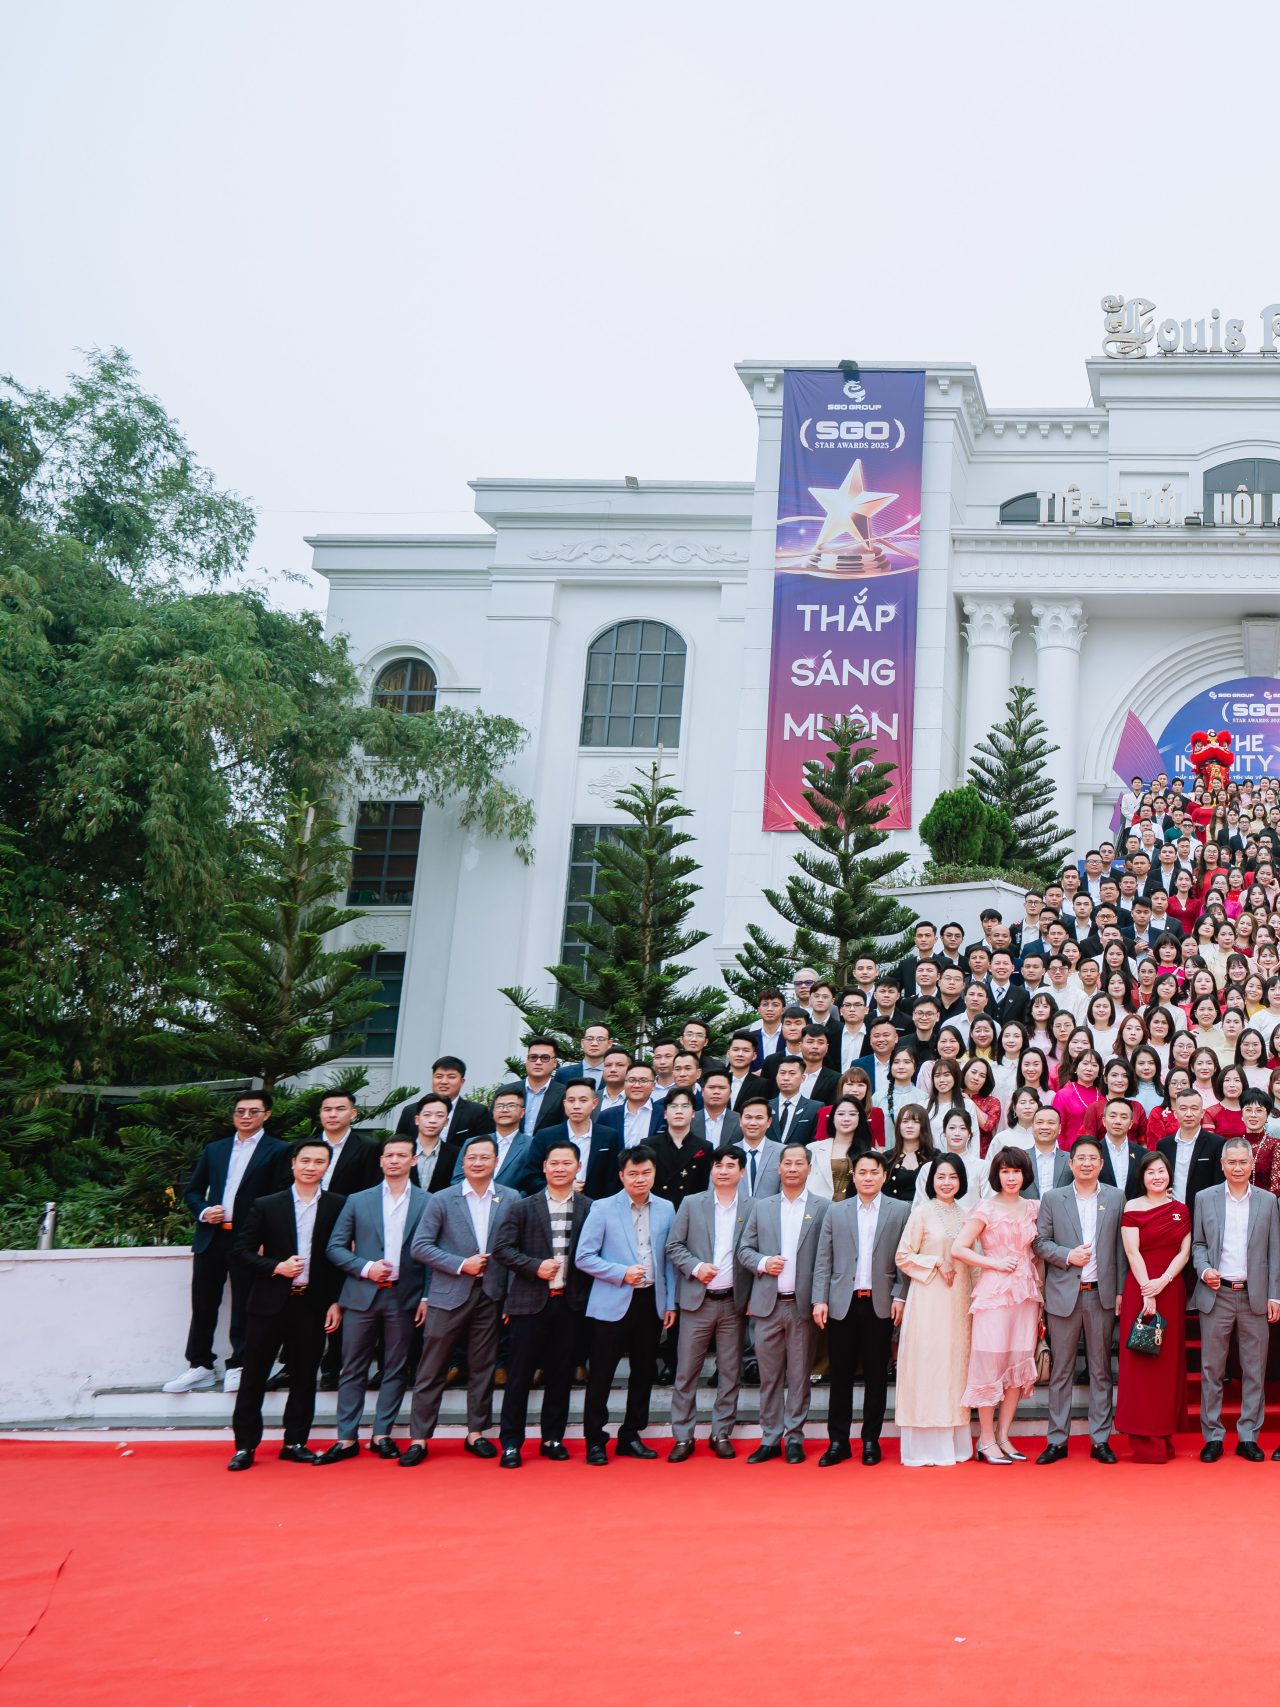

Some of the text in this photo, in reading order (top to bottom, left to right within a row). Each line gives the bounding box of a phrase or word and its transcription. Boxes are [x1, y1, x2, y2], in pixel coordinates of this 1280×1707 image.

[1100, 295, 1247, 359] Louis
[815, 441, 890, 449] STAR AWARDS 2025
[816, 421, 889, 440] SGO
[797, 587, 897, 632] THẮP
[791, 649, 896, 687] SÁNG
